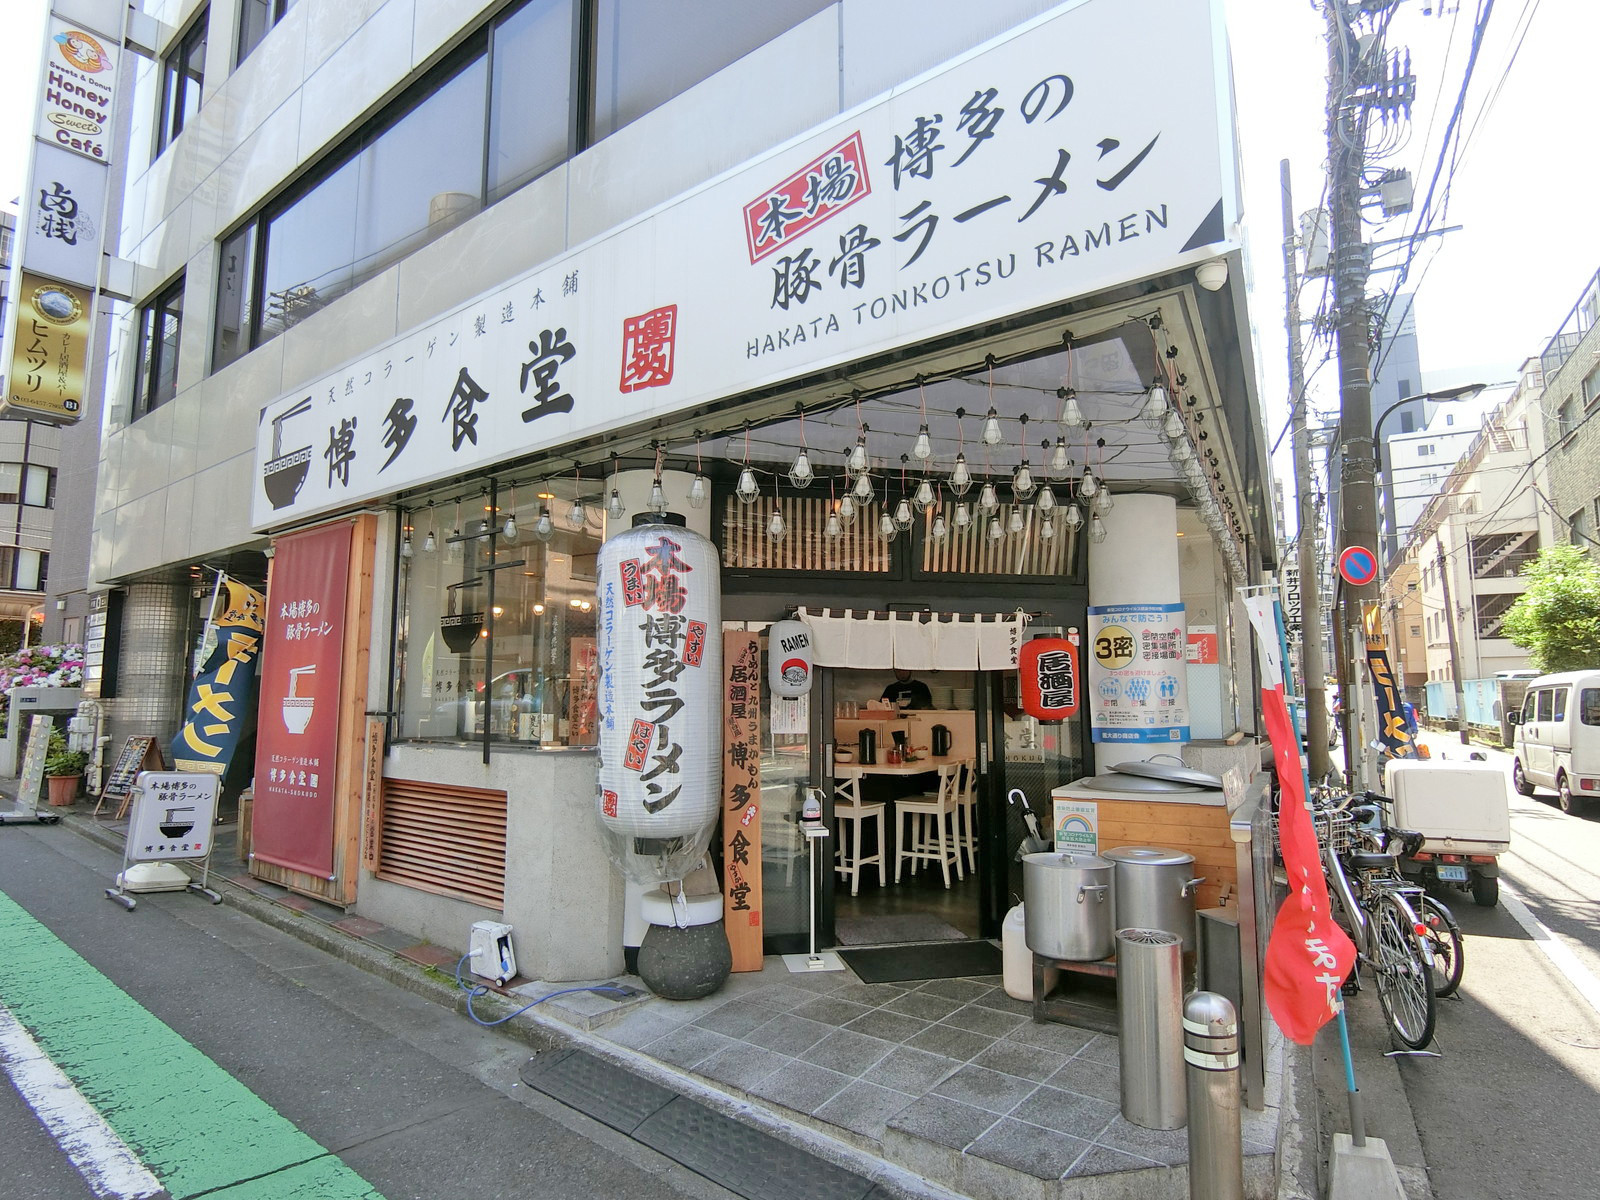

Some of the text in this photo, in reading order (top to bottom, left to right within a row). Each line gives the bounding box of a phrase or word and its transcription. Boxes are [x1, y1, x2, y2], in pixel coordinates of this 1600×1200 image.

[48, 70, 109, 108] Honey
[49, 60, 112, 93] Sweets & Donut
[46, 87, 108, 124] Honey
[53, 113, 98, 133] Sweets
[55, 128, 104, 158] Café
[754, 74, 1075, 248] 本場 博多の
[769, 130, 1162, 311] 豚骨ラーメン
[746, 203, 1170, 360] HAKATA TONKOTSU RAMEN
[26, 318, 49, 393] ヒムツリ
[327, 269, 579, 406] 天然コラーゲン製造本舗
[323, 327, 577, 490] 博多食堂
[623, 561, 643, 603] うまい
[279, 599, 321, 621] 本場博多の
[285, 620, 334, 641] 豚骨ラーメン
[686, 625, 704, 664] やすい
[780, 631, 811, 654] RAMEN
[1009, 627, 1018, 665] 博多食堂
[1096, 636, 1133, 660] 3密
[604, 582, 616, 731] 天然コラーゲン製造本舗
[729, 664, 749, 720] 居酒屋
[1037, 650, 1076, 709] 居酒屋
[748, 640, 759, 789] らーめんと 九州うまかもん
[628, 724, 651, 766] はやい
[150, 780, 198, 792] 本場博多の
[157, 790, 213, 802] 豚骨ラーメン
[269, 767, 307, 787] 博多食堂
[727, 741, 751, 912] 博多食堂
[144, 842, 190, 853] 博多食堂
